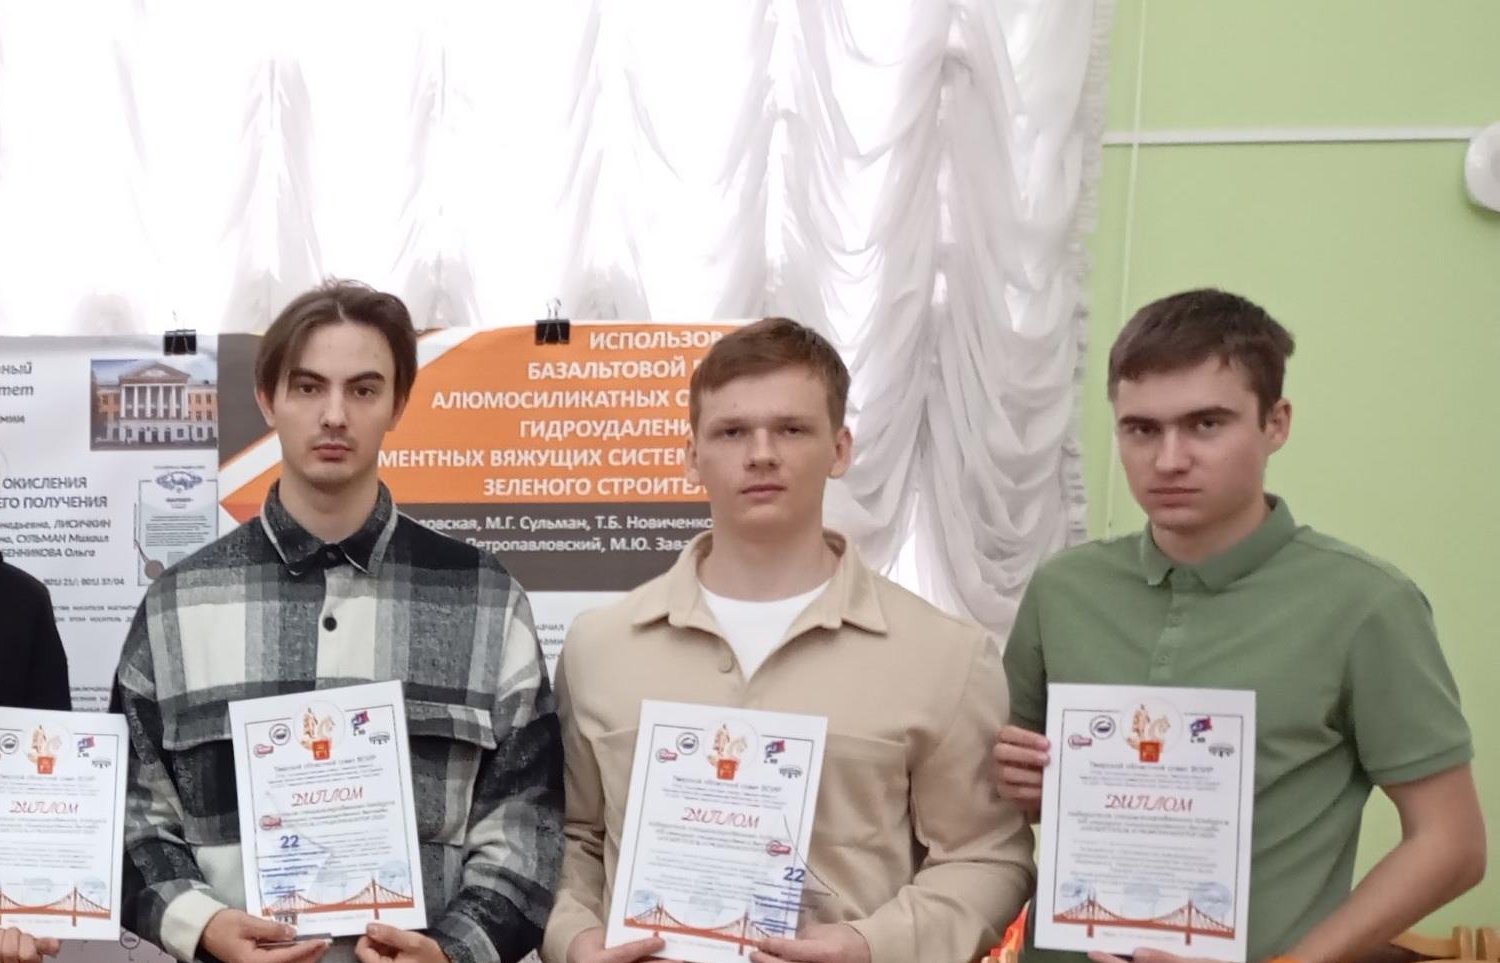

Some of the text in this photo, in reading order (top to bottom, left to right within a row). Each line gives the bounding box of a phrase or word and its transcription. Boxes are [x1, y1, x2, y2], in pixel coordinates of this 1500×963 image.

[590, 331, 723, 350] ИСПОЛЬЗОВ
[528, 356, 686, 380] БАЗАЛЬТОВОЙ
[431, 389, 669, 409] АЛЮМОСИЛИКАТНЫХ
[520, 419, 691, 441] ГИДРОУДАЛЕНИ
[378, 449, 484, 468] МЕНТНЫХ
[491, 448, 601, 470] ВЯЖУЩИХ
[2, 477, 88, 490] ОКИСЛЕНИЯ
[484, 478, 590, 497] ЗЕЛЕНОГО
[23, 496, 108, 509] ПОЛУЧЕНИЯ
[485, 516, 516, 530] М.Г.
[520, 515, 590, 535] Сульман,
[627, 514, 713, 530] Новиченко
[610, 536, 650, 551] М.Ю.
[280, 835, 300, 849] 22
[784, 866, 806, 883] 22
